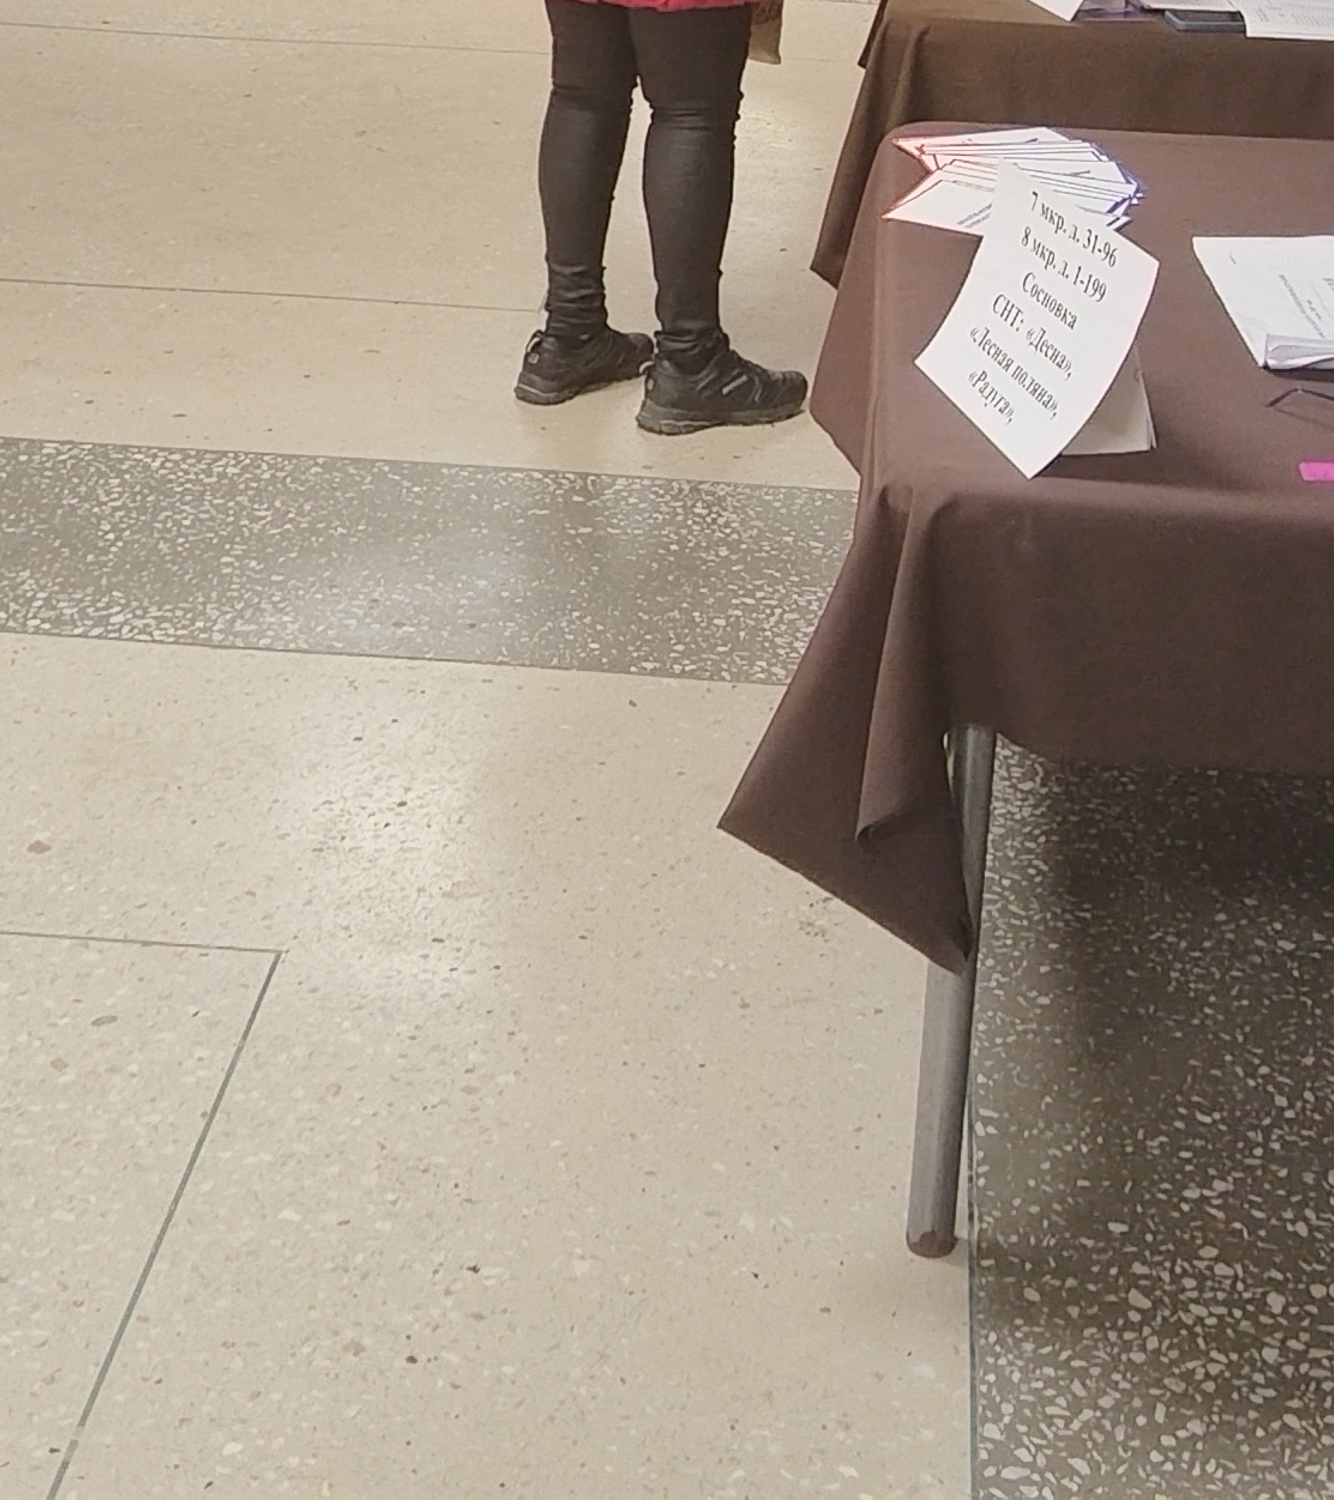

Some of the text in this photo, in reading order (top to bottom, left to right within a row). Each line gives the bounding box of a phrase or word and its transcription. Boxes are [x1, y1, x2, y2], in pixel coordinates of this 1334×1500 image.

[1021, 226, 1107, 303] 8 мкр. д. 1-199
[1031, 191, 1119, 268] 7 мкр. д. 31-96
[992, 294, 1072, 381] СНТ: «Десна»,
[1022, 271, 1078, 330] Сосновка
[968, 370, 1015, 425] «Радуга»,
[970, 326, 1058, 421] «Лесная поляна»,
